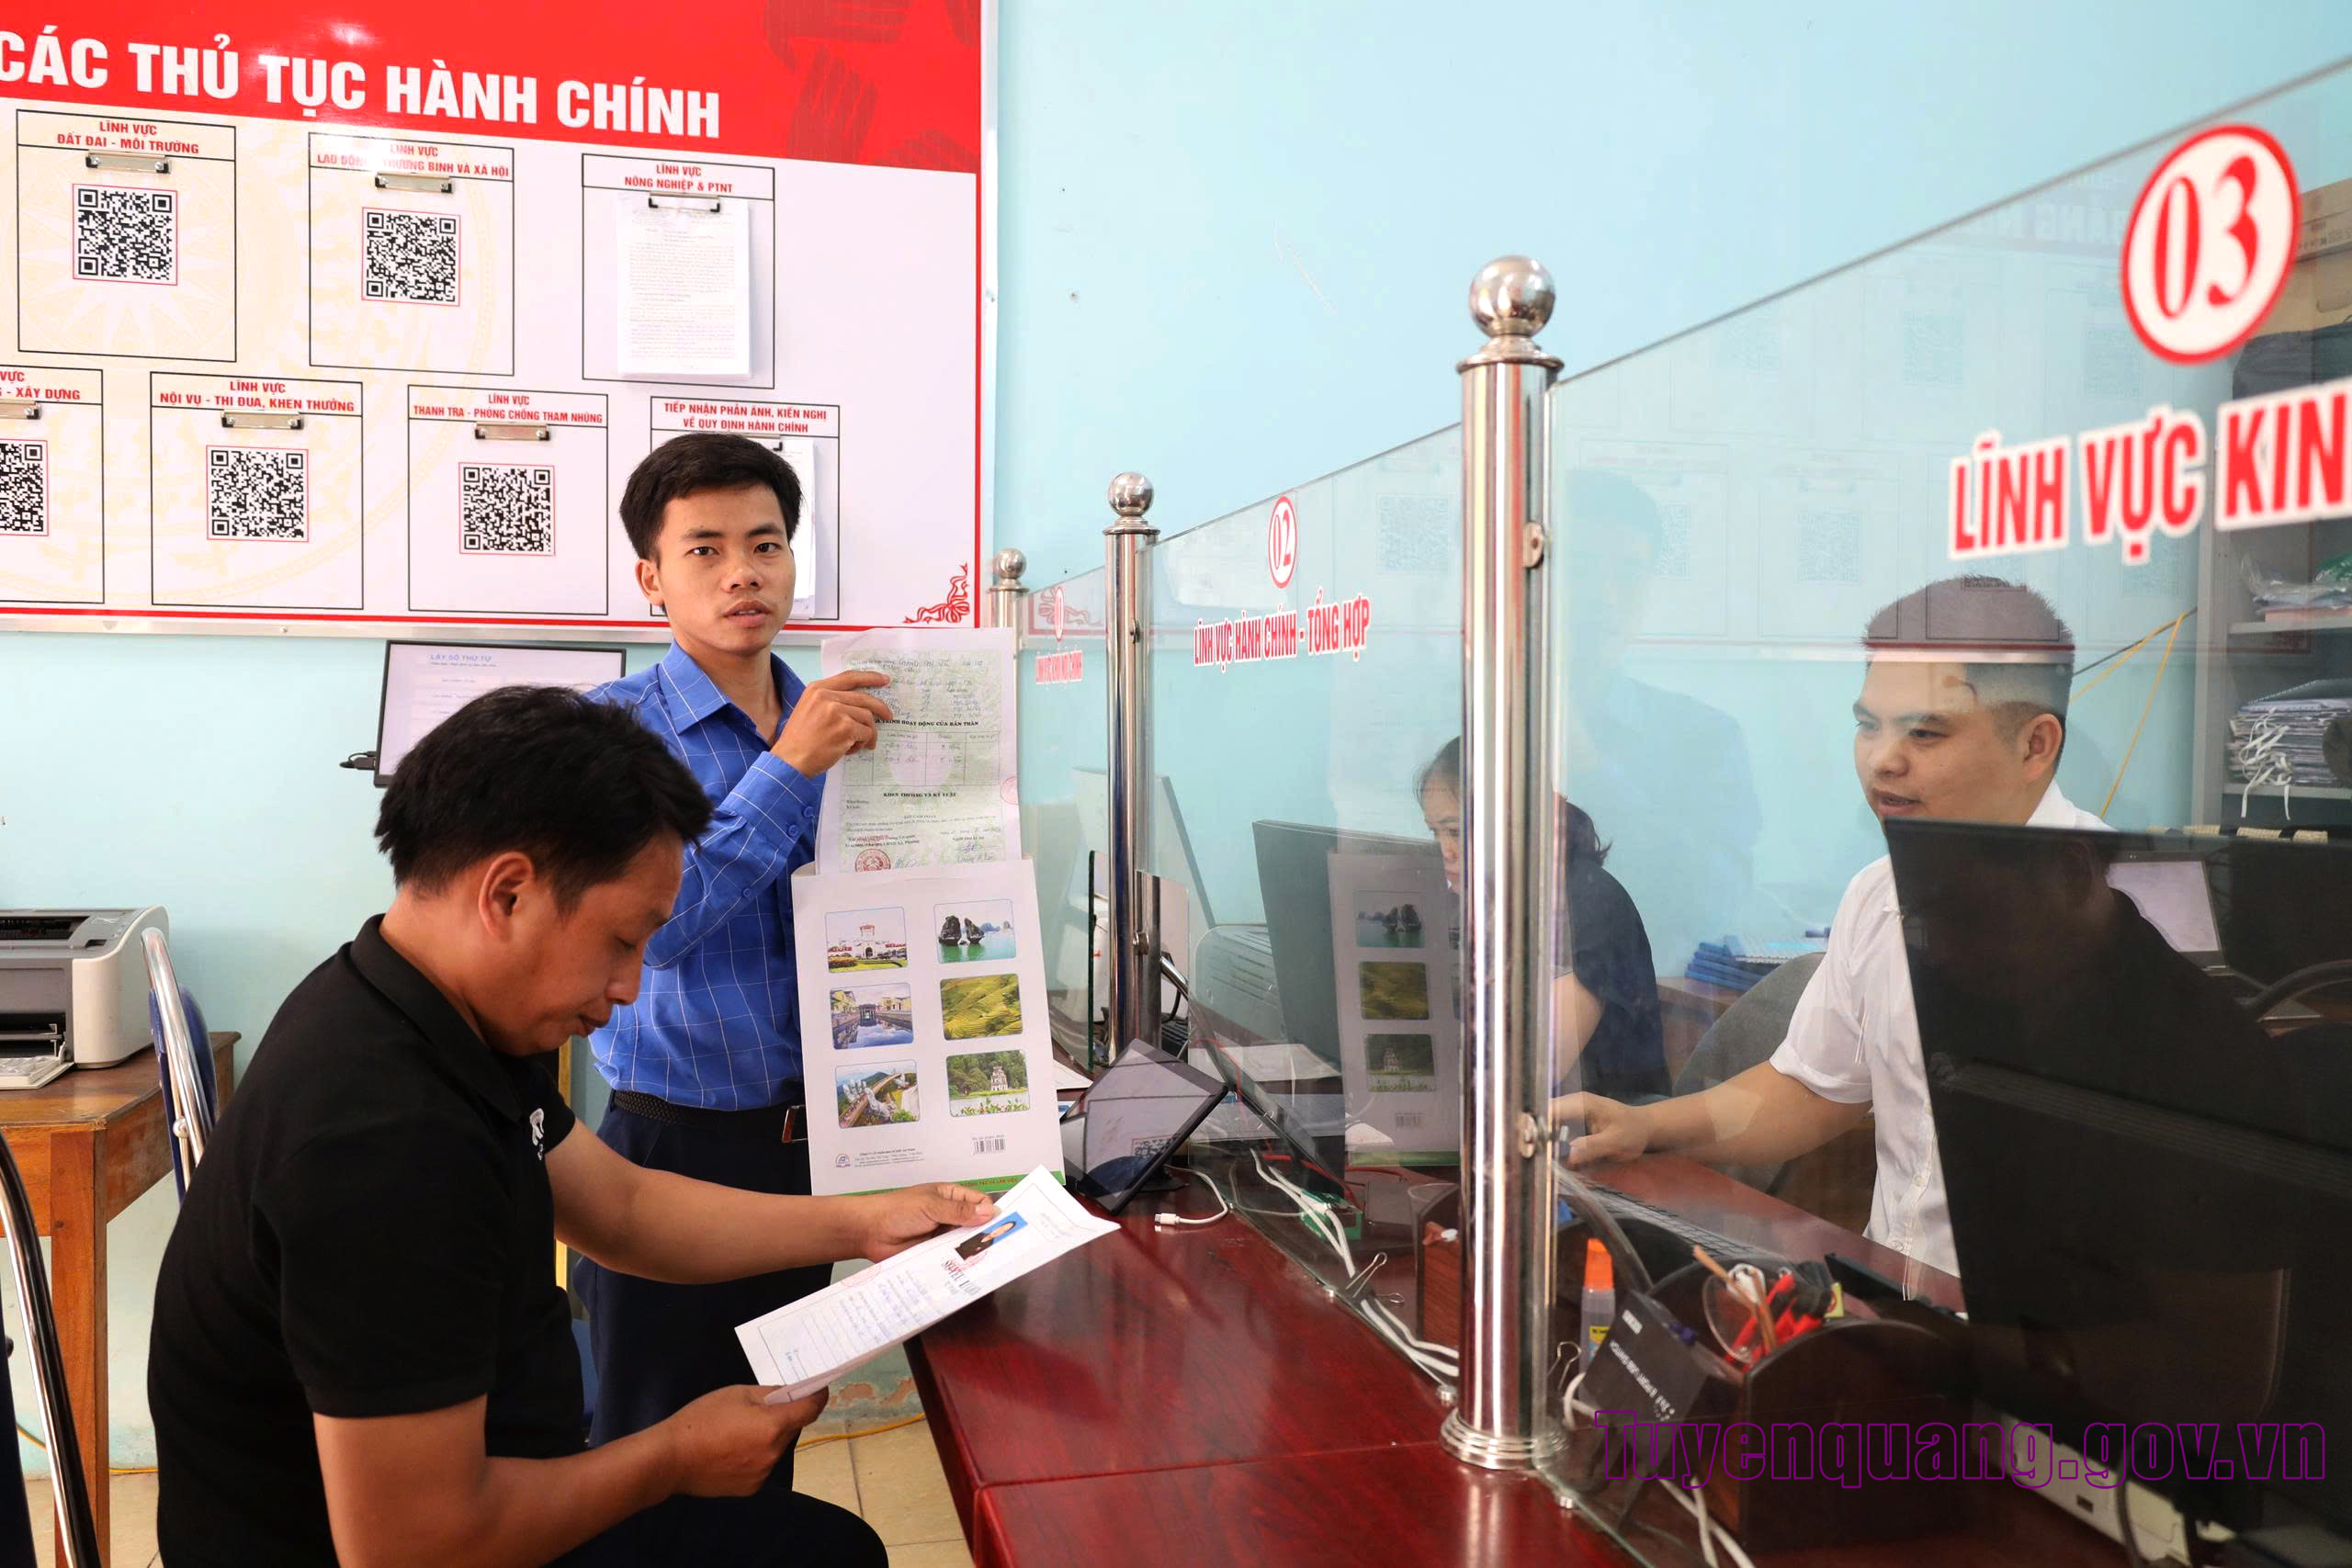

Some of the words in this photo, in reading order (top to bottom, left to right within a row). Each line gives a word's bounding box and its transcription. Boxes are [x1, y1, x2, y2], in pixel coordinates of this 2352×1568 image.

[0, 25, 108, 88] CÁC
[128, 33, 239, 99] THỦ
[258, 54, 366, 117] TỤC
[386, 59, 537, 124] HÀNH
[557, 76, 719, 139] CHÍNH
[99, 120, 129, 134] LĨNH
[132, 123, 157, 137] VỰC
[85, 135, 107, 147] ĐAI
[120, 137, 144, 150] MÔI
[150, 139, 199, 154] TRƯỜNG
[417, 145, 438, 158] VỰC
[317, 153, 337, 164] LAO
[428, 160, 454, 173] BINH
[457, 162, 470, 174] VÀ
[473, 163, 488, 175] XÃ
[491, 164, 509, 177] HỘI
[656, 164, 679, 175] LĨNH
[682, 166, 702, 178] VỰC
[625, 175, 653, 188] NÔNG
[656, 178, 694, 192] NGHIỆP
[697, 181, 705, 192] &
[707, 183, 733, 193] PTNT
[2154, 154, 2260, 320] 03
[0, 370, 25, 384] VỰC
[16, 386, 40, 398] XÂY
[45, 388, 80, 401] DỰNG
[230, 379, 258, 391] LĨNH
[262, 381, 286, 395] VỰC
[160, 391, 181, 404] NỘI
[186, 393, 201, 407] VỤ
[214, 395, 233, 406] THI
[237, 396, 266, 409] ĐUA,
[269, 398, 302, 410] KHEN
[305, 398, 355, 412] THƯỞNG
[488, 393, 510, 405] LĨNH
[512, 395, 530, 407] VỰC
[413, 405, 445, 416] THANH
[447, 407, 464, 417] TRA
[473, 407, 505, 419] PHÒNG
[508, 408, 539, 421] CHỐNG
[543, 411, 568, 422] THAM
[664, 400, 686, 412] TIẾP
[688, 402, 718, 416] NHẬN
[776, 405, 800, 419] KIẾN
[802, 410, 827, 422] NGHỊ
[683, 416, 695, 428] VỀ
[698, 419, 718, 429] QUY
[720, 420, 745, 432] ĐỊNH
[748, 420, 775, 432] HÀNH
[777, 421, 808, 433] CHÍNH
[1953, 440, 2067, 553] LĨNH
[2085, 414, 2200, 558] VỰC
[1272, 508, 1292, 570] 02
[1193, 619, 1214, 665] LĨNH
[1216, 619, 1233, 671] VỰC
[1235, 611, 1261, 660] HÀNH
[1263, 604, 1296, 659] CHÍNH
[1307, 588, 1340, 653] TỔNG
[1343, 593, 1370, 660] HỢP
